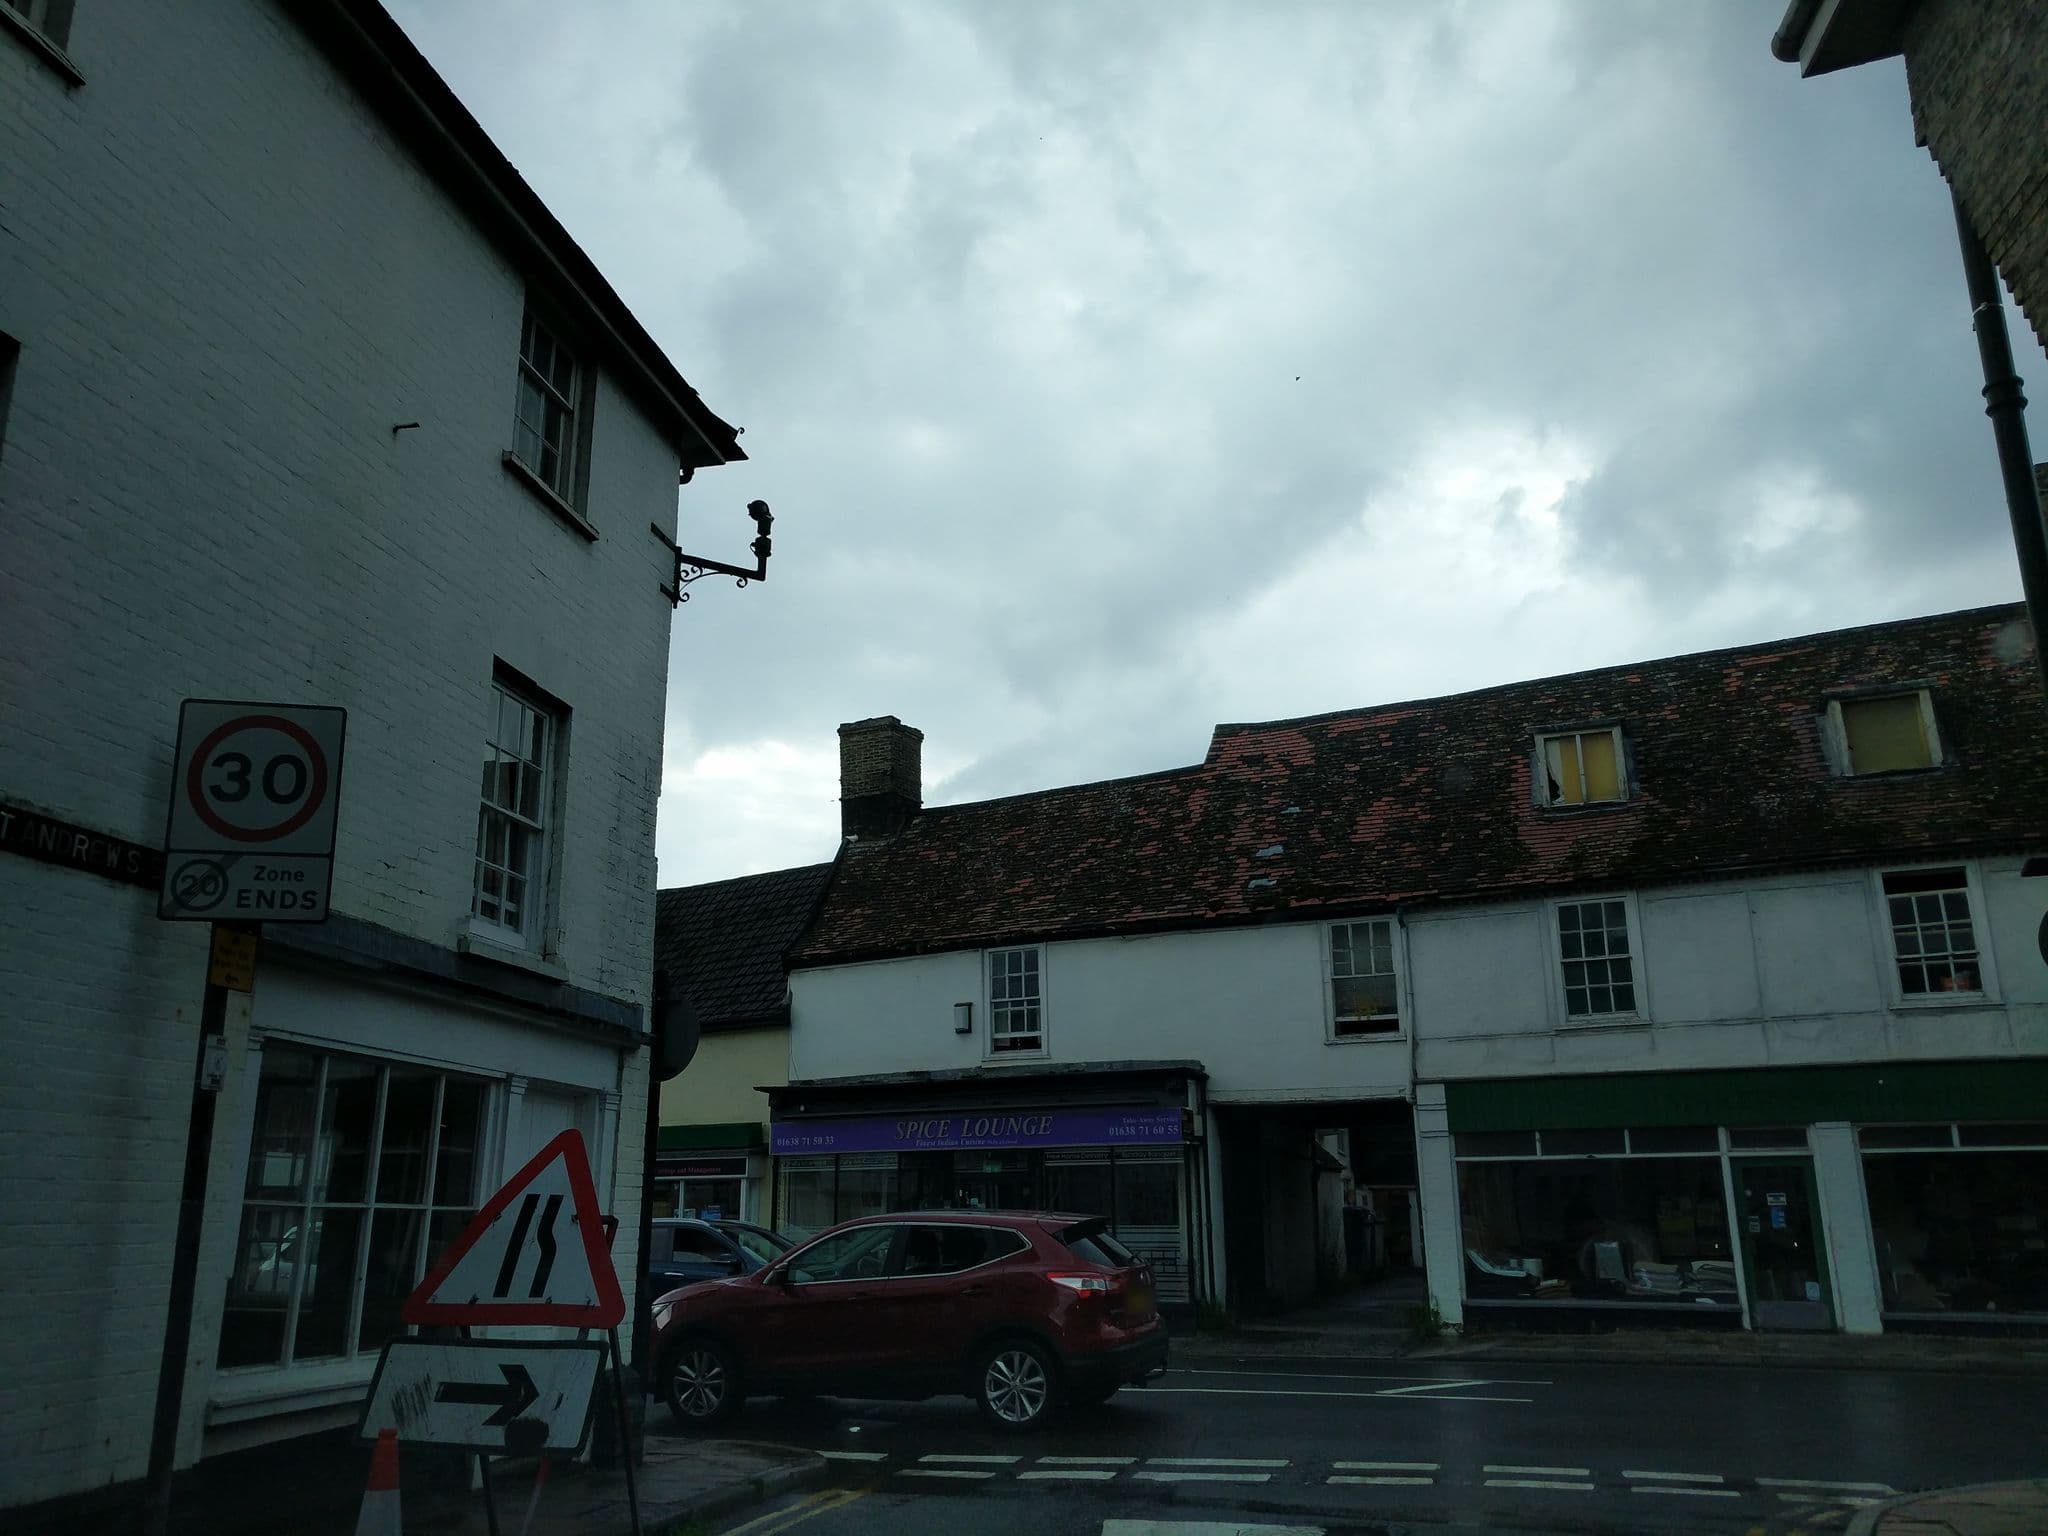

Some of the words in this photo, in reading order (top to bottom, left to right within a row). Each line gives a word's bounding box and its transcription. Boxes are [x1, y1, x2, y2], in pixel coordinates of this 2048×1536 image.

[209, 752, 308, 804] 30
[23, 819, 141, 874] ANDREWS
[180, 874, 220, 898] 20
[253, 865, 305, 883] Zone
[236, 889, 319, 910] ENDS
[896, 1119, 951, 1140] SPICE
[961, 1116, 1054, 1137] LOUNGE
[1109, 1126, 1136, 1136] 01638
[1139, 1126, 1149, 1135] 71
[1167, 1125, 1179, 1134] 55
[777, 1136, 799, 1146] 01638
[802, 1136, 810, 1145] 71
[825, 1136, 834, 1145] 33
